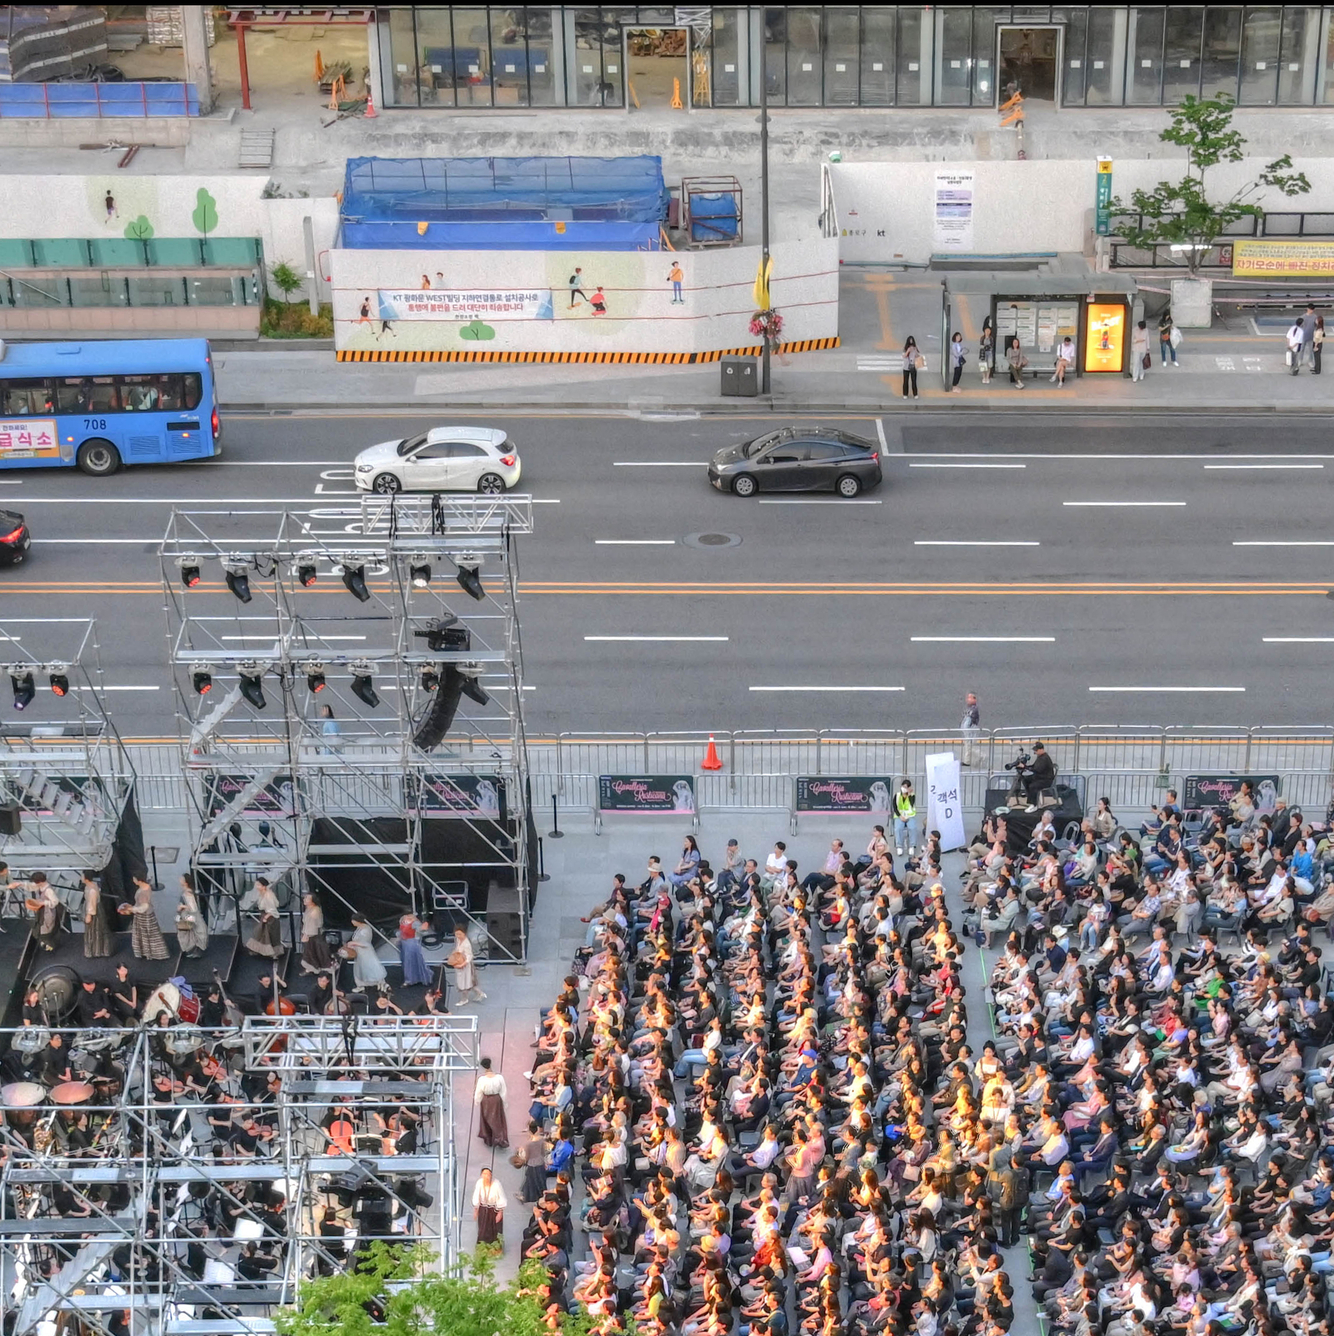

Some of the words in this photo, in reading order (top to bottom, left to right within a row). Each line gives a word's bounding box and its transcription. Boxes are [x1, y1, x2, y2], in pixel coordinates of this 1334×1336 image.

[877, 229, 886, 237] kt
[1236, 260, 1285, 270] 자기모순에
[393, 294, 403, 302] KT
[404, 294, 424, 303] 광화문
[426, 294, 460, 303] WEST빌딩
[467, 303, 488, 312] 대단히
[83, 419, 107, 430] 708
[937, 788, 959, 804] 객석
[945, 808, 953, 818] D
